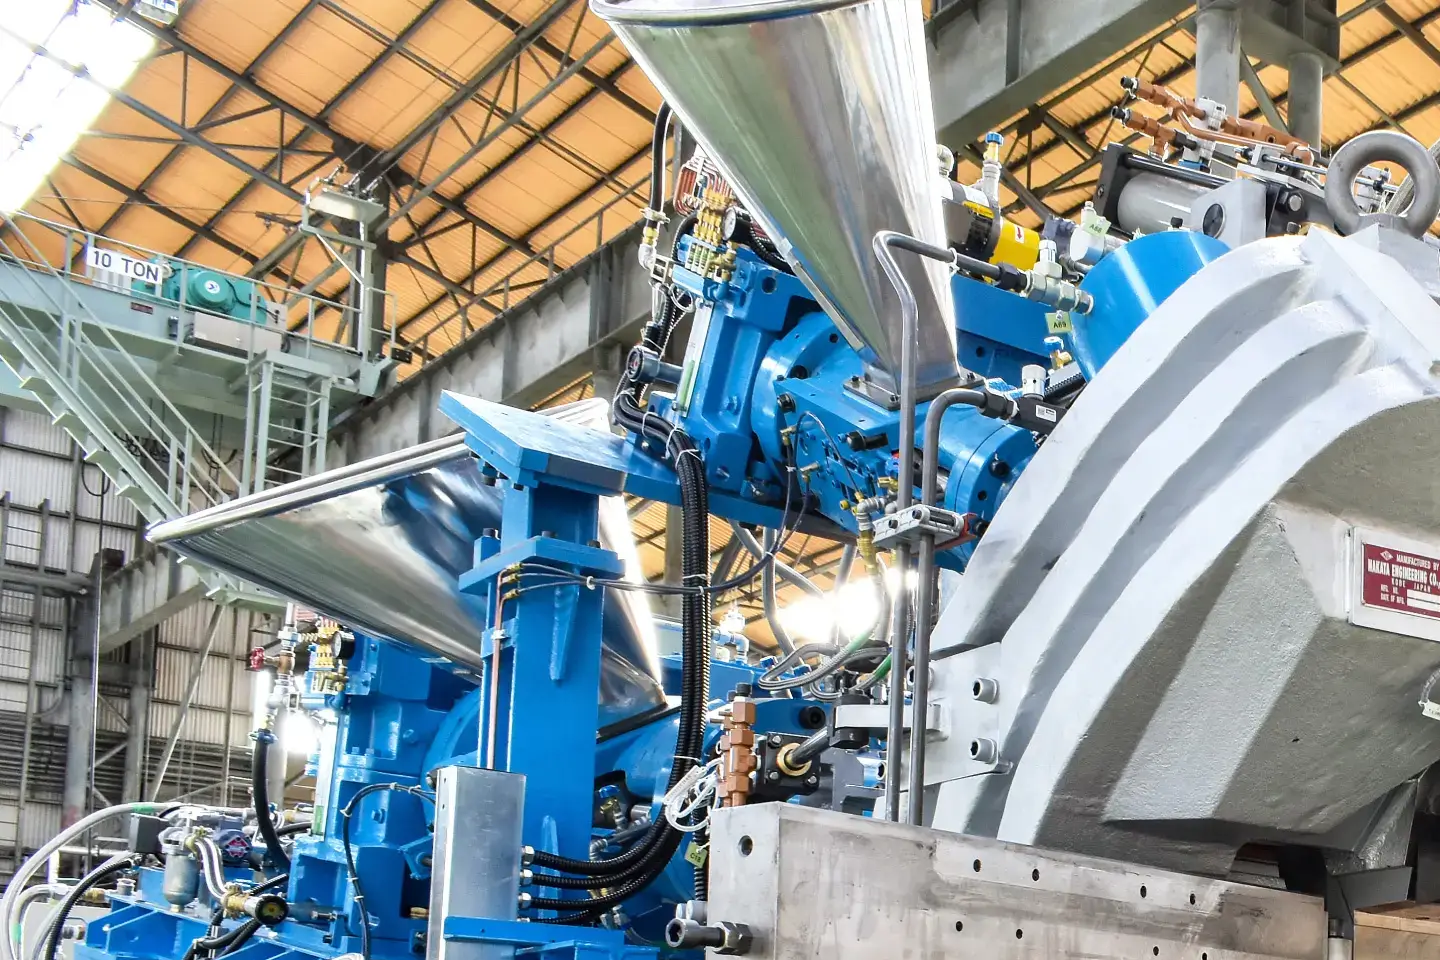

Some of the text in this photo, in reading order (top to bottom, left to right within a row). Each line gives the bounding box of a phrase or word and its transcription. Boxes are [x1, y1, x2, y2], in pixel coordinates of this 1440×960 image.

[93, 250, 159, 282] 10 TON
[1367, 558, 1390, 577] NAKATA
[1391, 564, 1428, 585] ENGINEERING
[1396, 554, 1440, 572] MANUFACTURED BY
[1391, 577, 1431, 593] KOBE JAPAN
